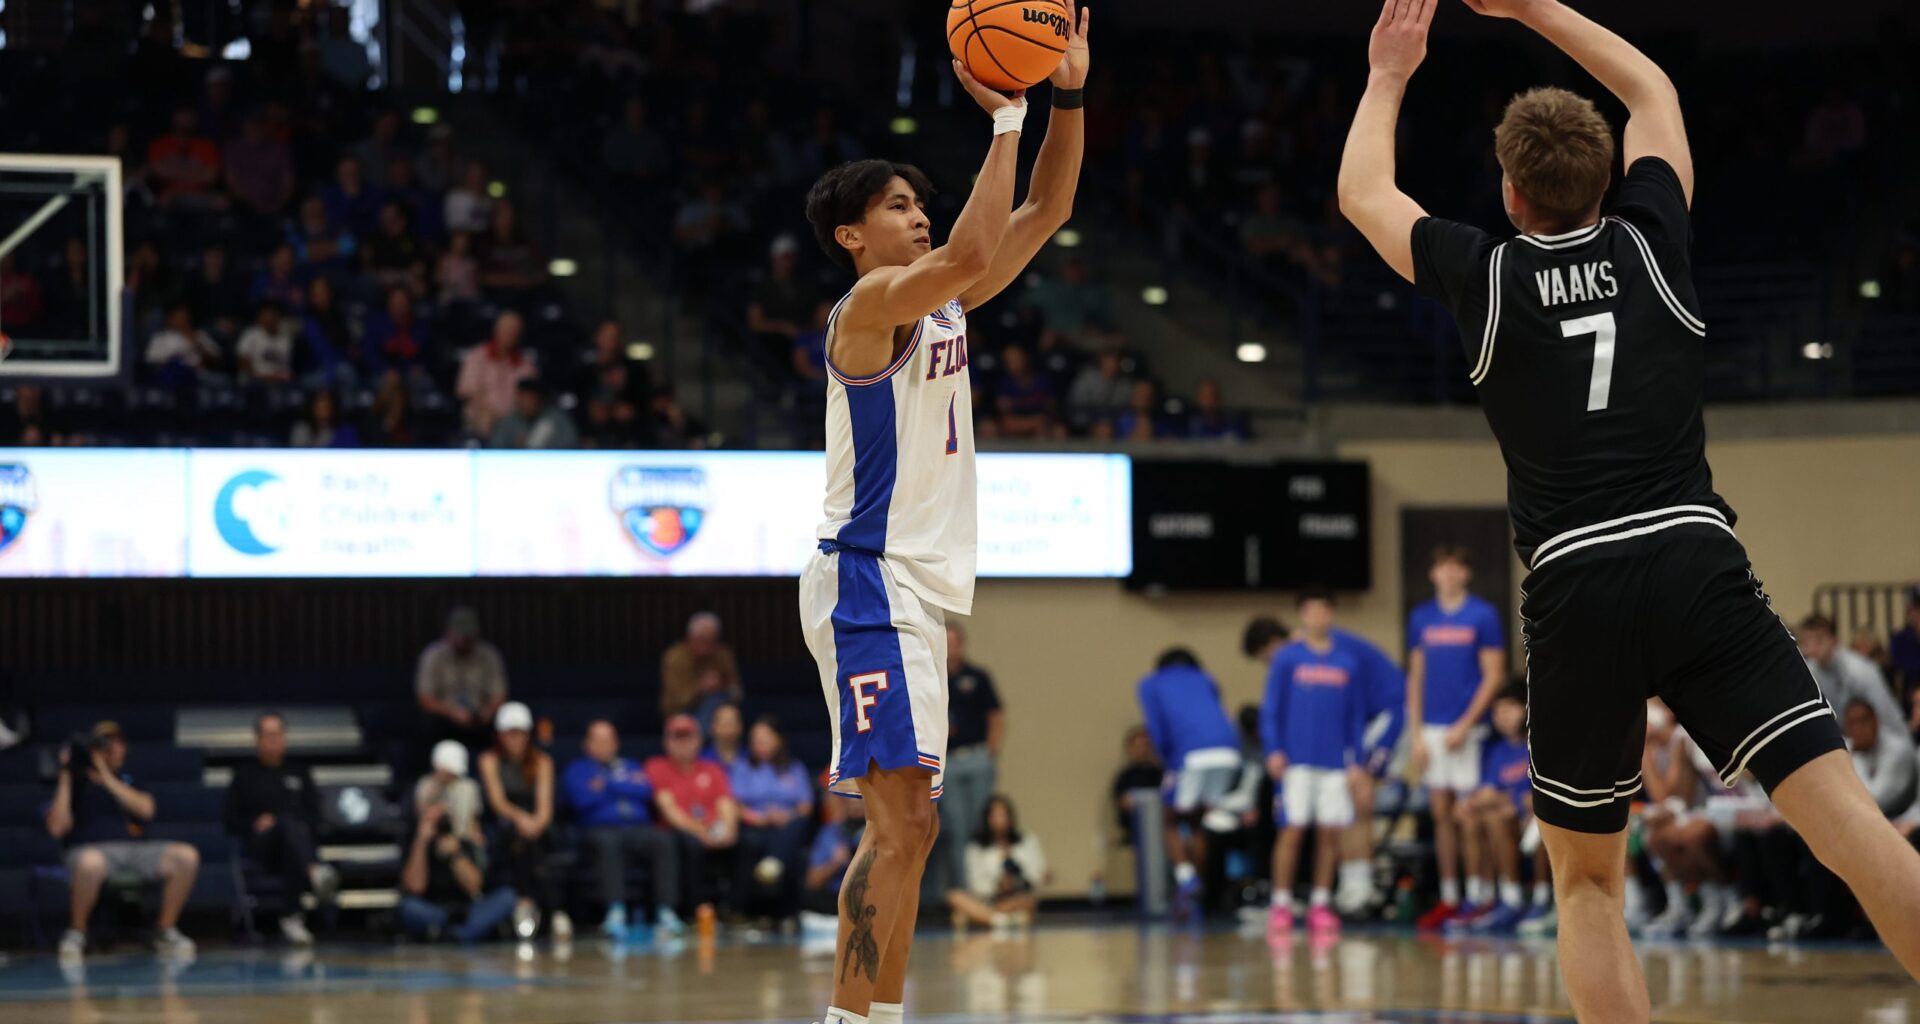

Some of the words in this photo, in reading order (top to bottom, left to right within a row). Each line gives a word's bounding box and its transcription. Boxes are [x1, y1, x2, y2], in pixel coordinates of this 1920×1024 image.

[1535, 260, 1618, 307] VAAKS
[926, 335, 968, 381] FLO
[1560, 311, 1616, 412] 7
[945, 391, 958, 455] 1
[849, 670, 889, 733] F
